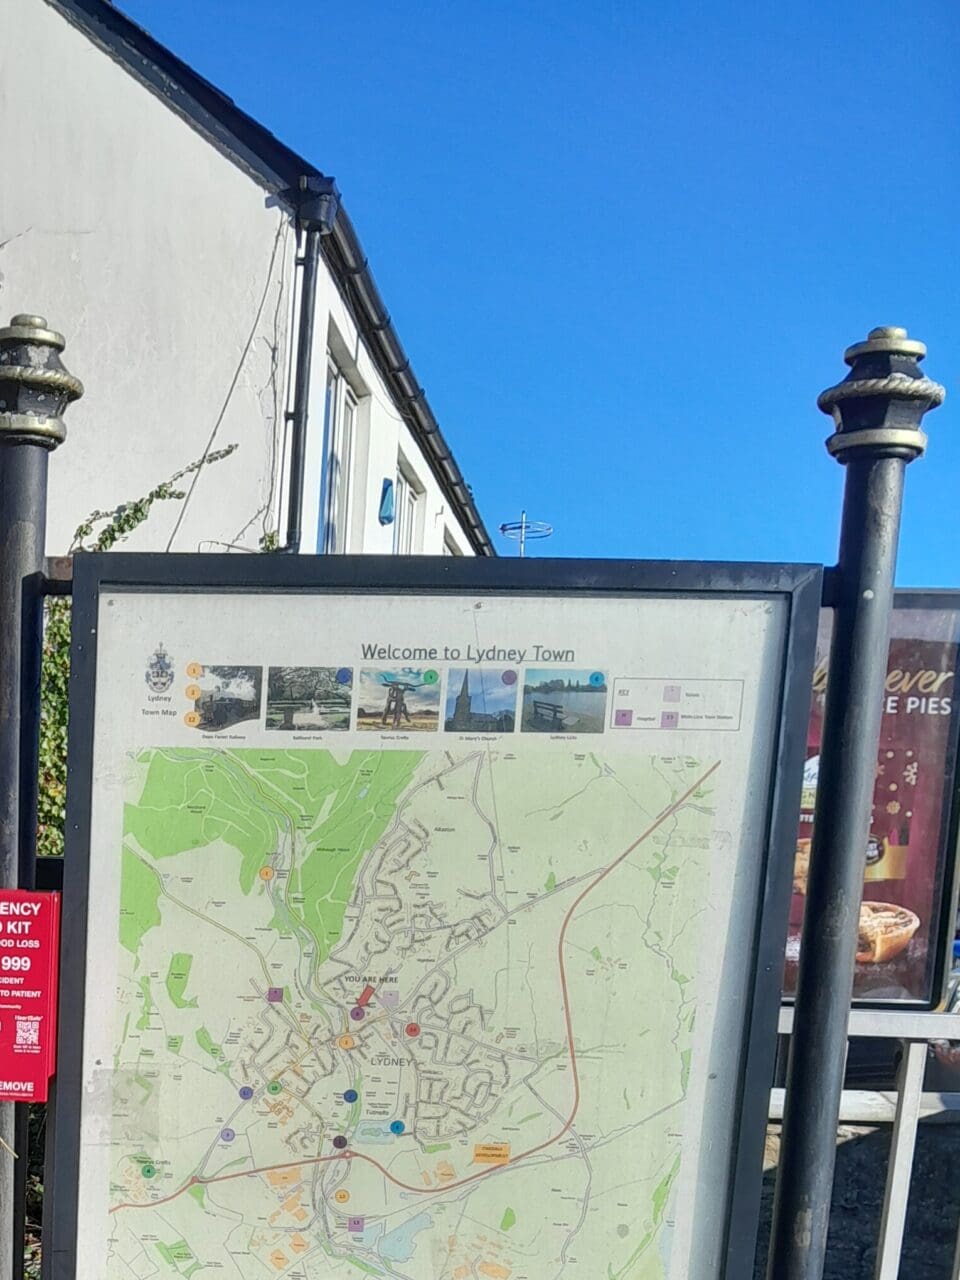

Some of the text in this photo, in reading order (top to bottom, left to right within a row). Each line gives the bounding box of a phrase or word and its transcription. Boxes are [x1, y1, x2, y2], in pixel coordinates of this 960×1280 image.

[361, 643, 574, 664] Welcome to Lydney Town
[885, 669, 954, 693] ever
[906, 697, 952, 715] PIES
[7, 921, 32, 934] KIT
[16, 940, 40, 948] LOSS
[1, 956, 31, 971] 999
[11, 990, 41, 998] PATIENT
[371, 1058, 411, 1066] LYDNEY
